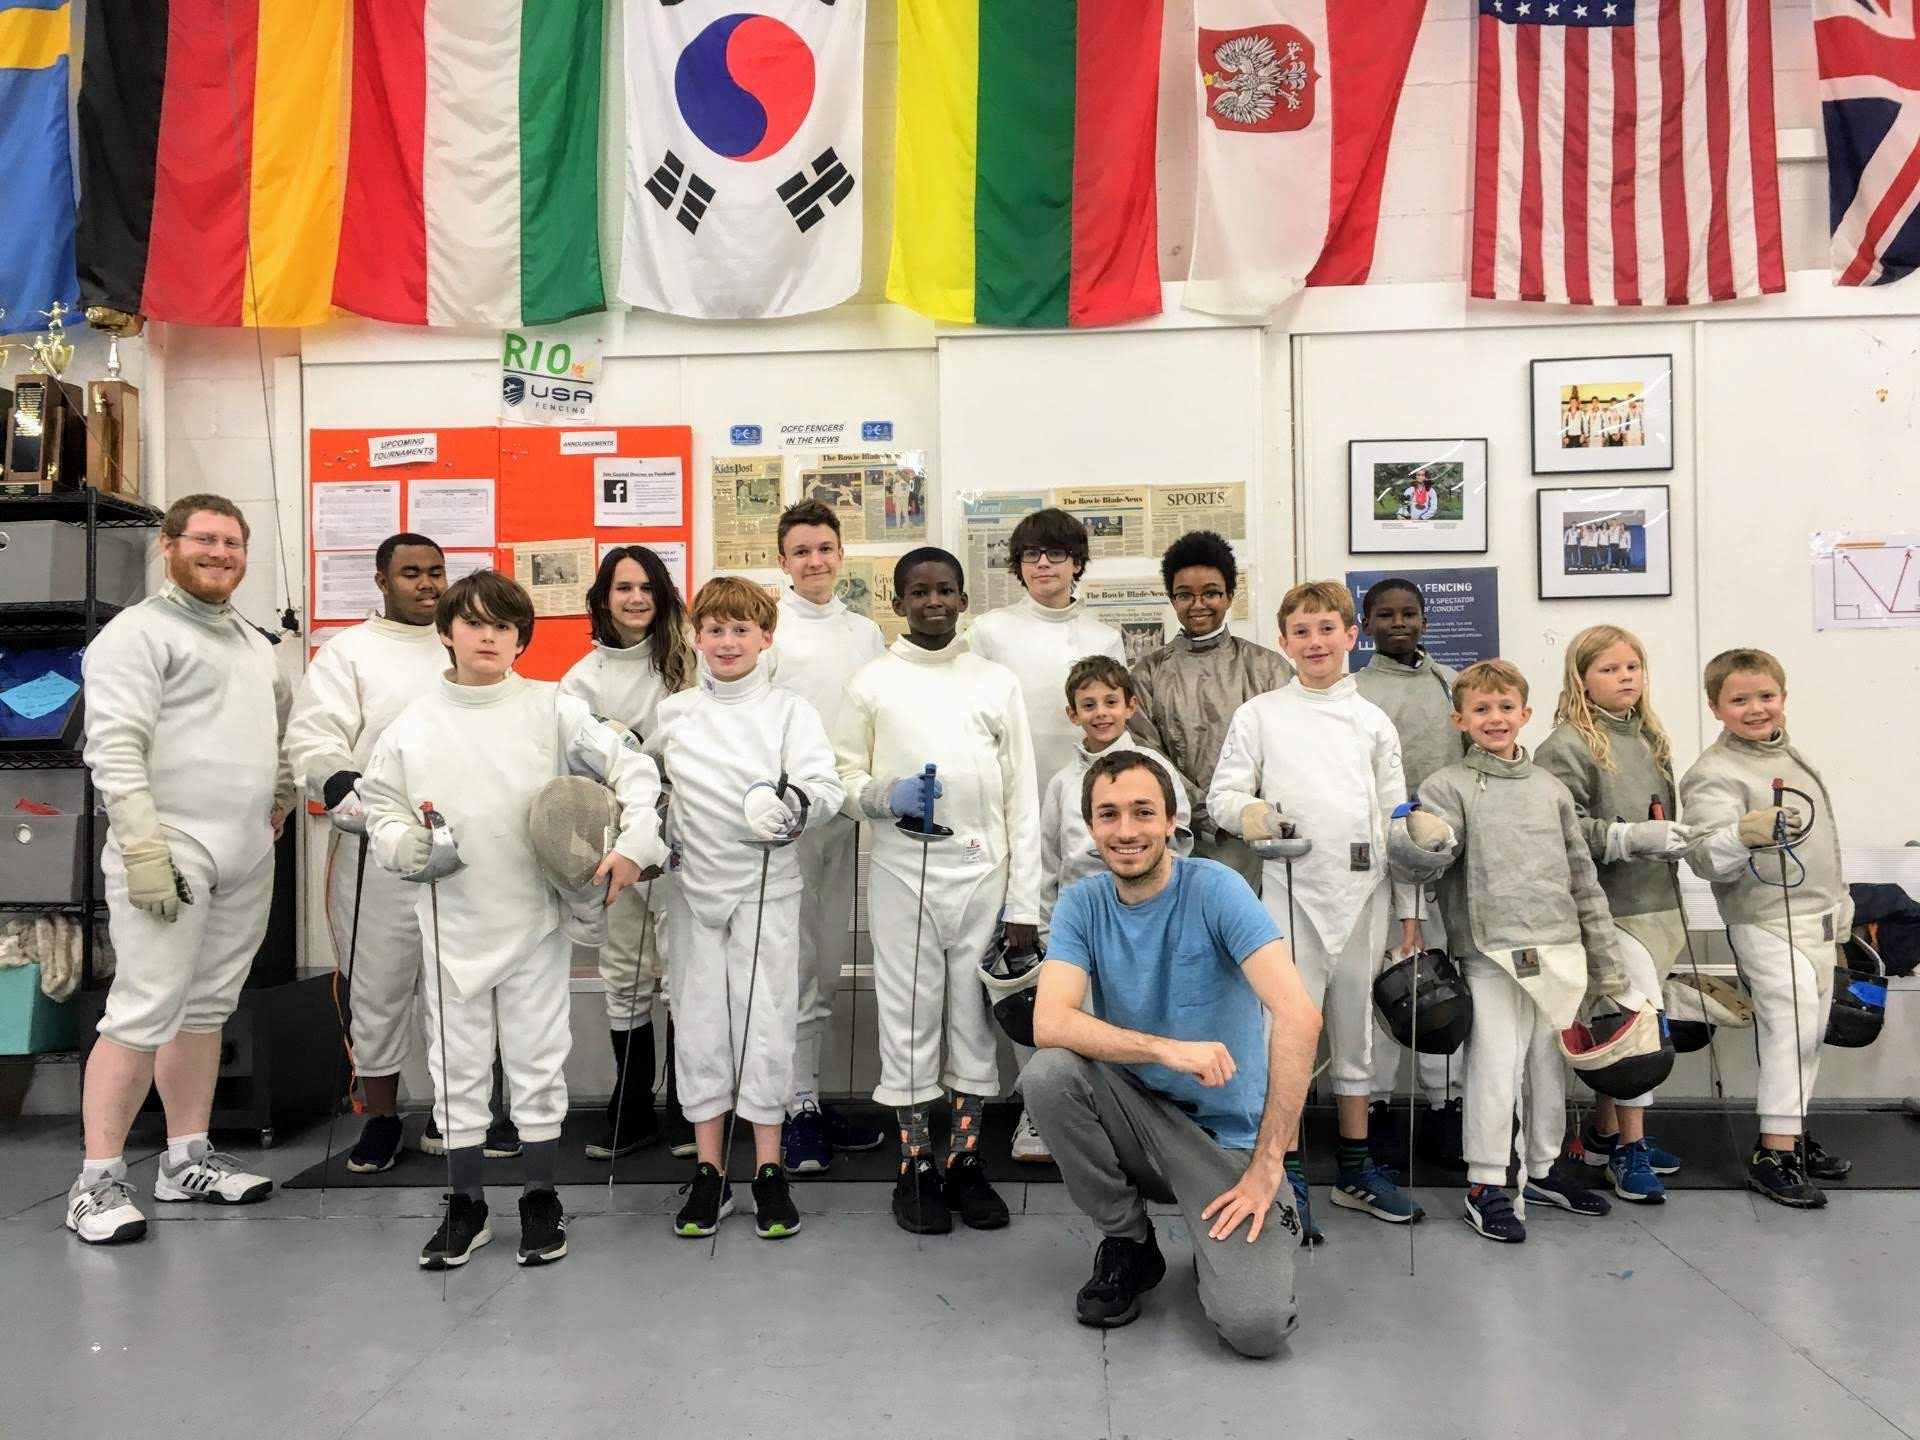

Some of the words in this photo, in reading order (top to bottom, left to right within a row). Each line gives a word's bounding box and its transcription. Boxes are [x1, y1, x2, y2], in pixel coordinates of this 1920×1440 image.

[503, 333, 571, 375] RIO
[531, 385, 593, 403] USA
[535, 402, 585, 415] FENCING
[781, 425, 804, 433] DCFC
[805, 424, 844, 432] FENCERS
[380, 438, 425, 449] UPCOMING
[798, 436, 813, 444] THE
[815, 435, 840, 443] NEWS
[373, 447, 435, 461] TOURNAMENTS
[1078, 497, 1101, 505] Bowie
[1102, 496, 1143, 504] Blade-News
[1167, 491, 1225, 506] SPORTS
[1424, 582, 1473, 593] FENCING
[1086, 592, 1100, 600] The
[1436, 596, 1475, 605] SPECTATOR
